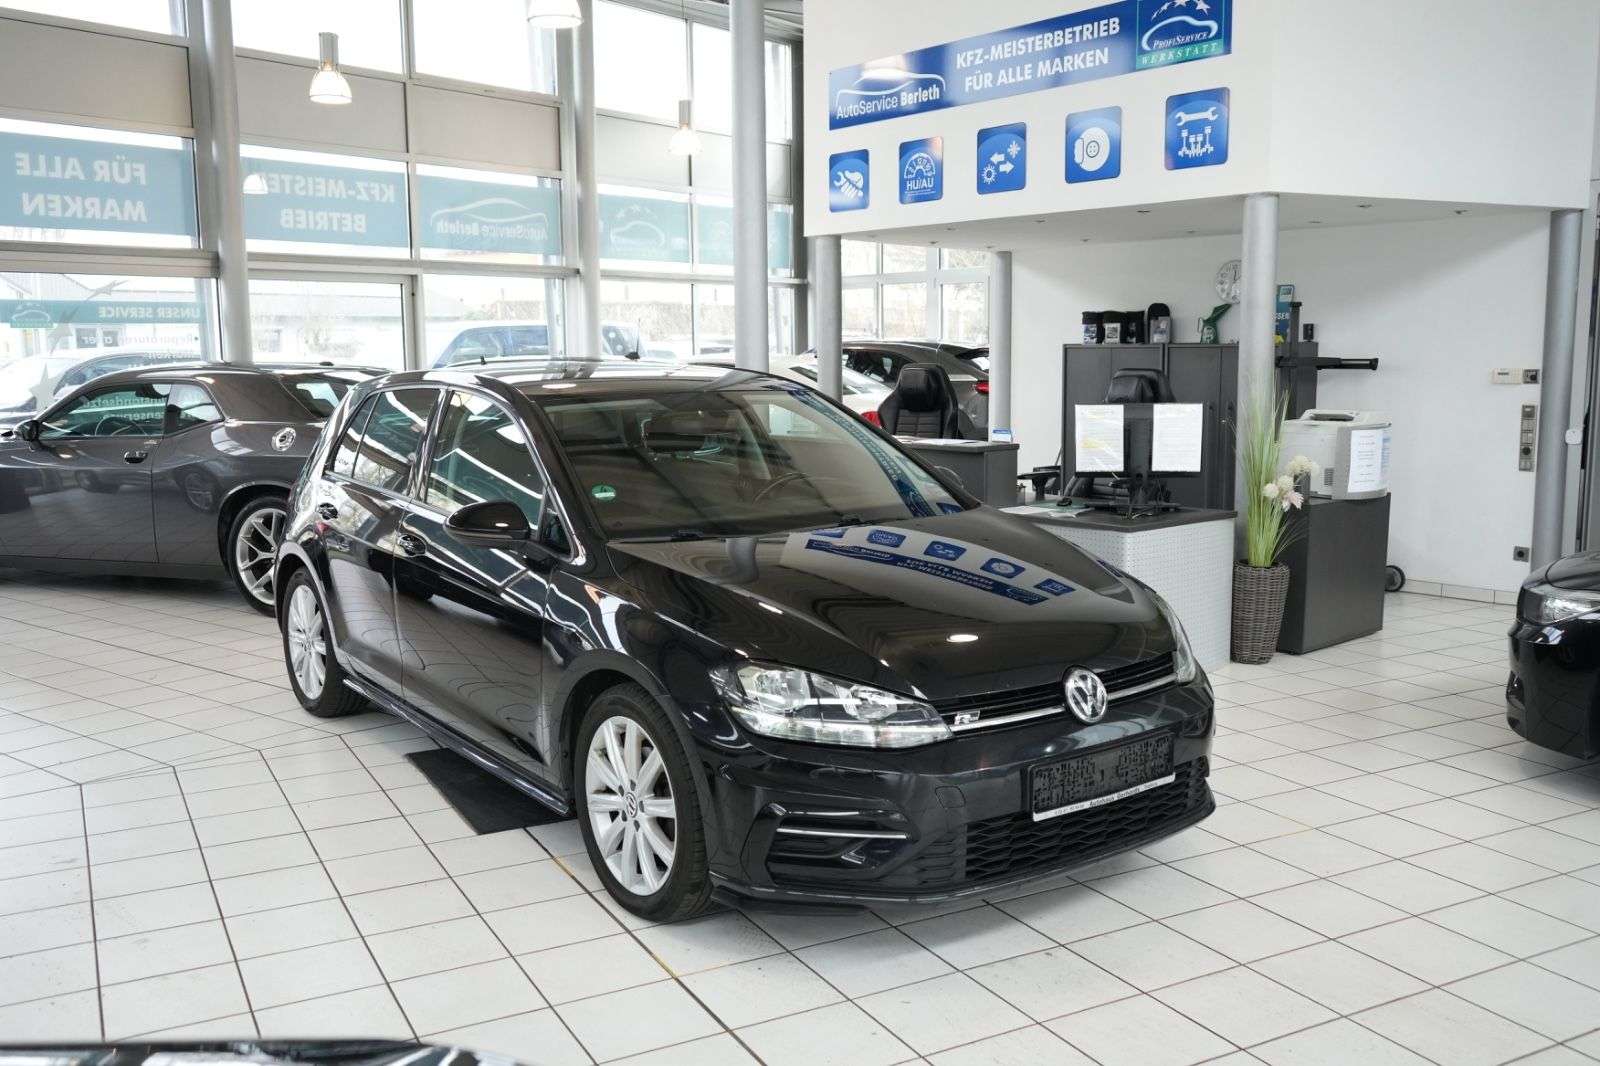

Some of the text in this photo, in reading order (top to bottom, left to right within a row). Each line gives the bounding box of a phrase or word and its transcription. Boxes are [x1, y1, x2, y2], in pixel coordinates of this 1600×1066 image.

[956, 16, 1121, 69] KFZ-MEISTERBETRIEB
[1142, 42, 1218, 65] WERKSTATT
[964, 47, 1110, 93] FÜR ALLE MARKEN
[836, 84, 940, 119] AutoService Berleth
[906, 177, 934, 191] HU/AU
